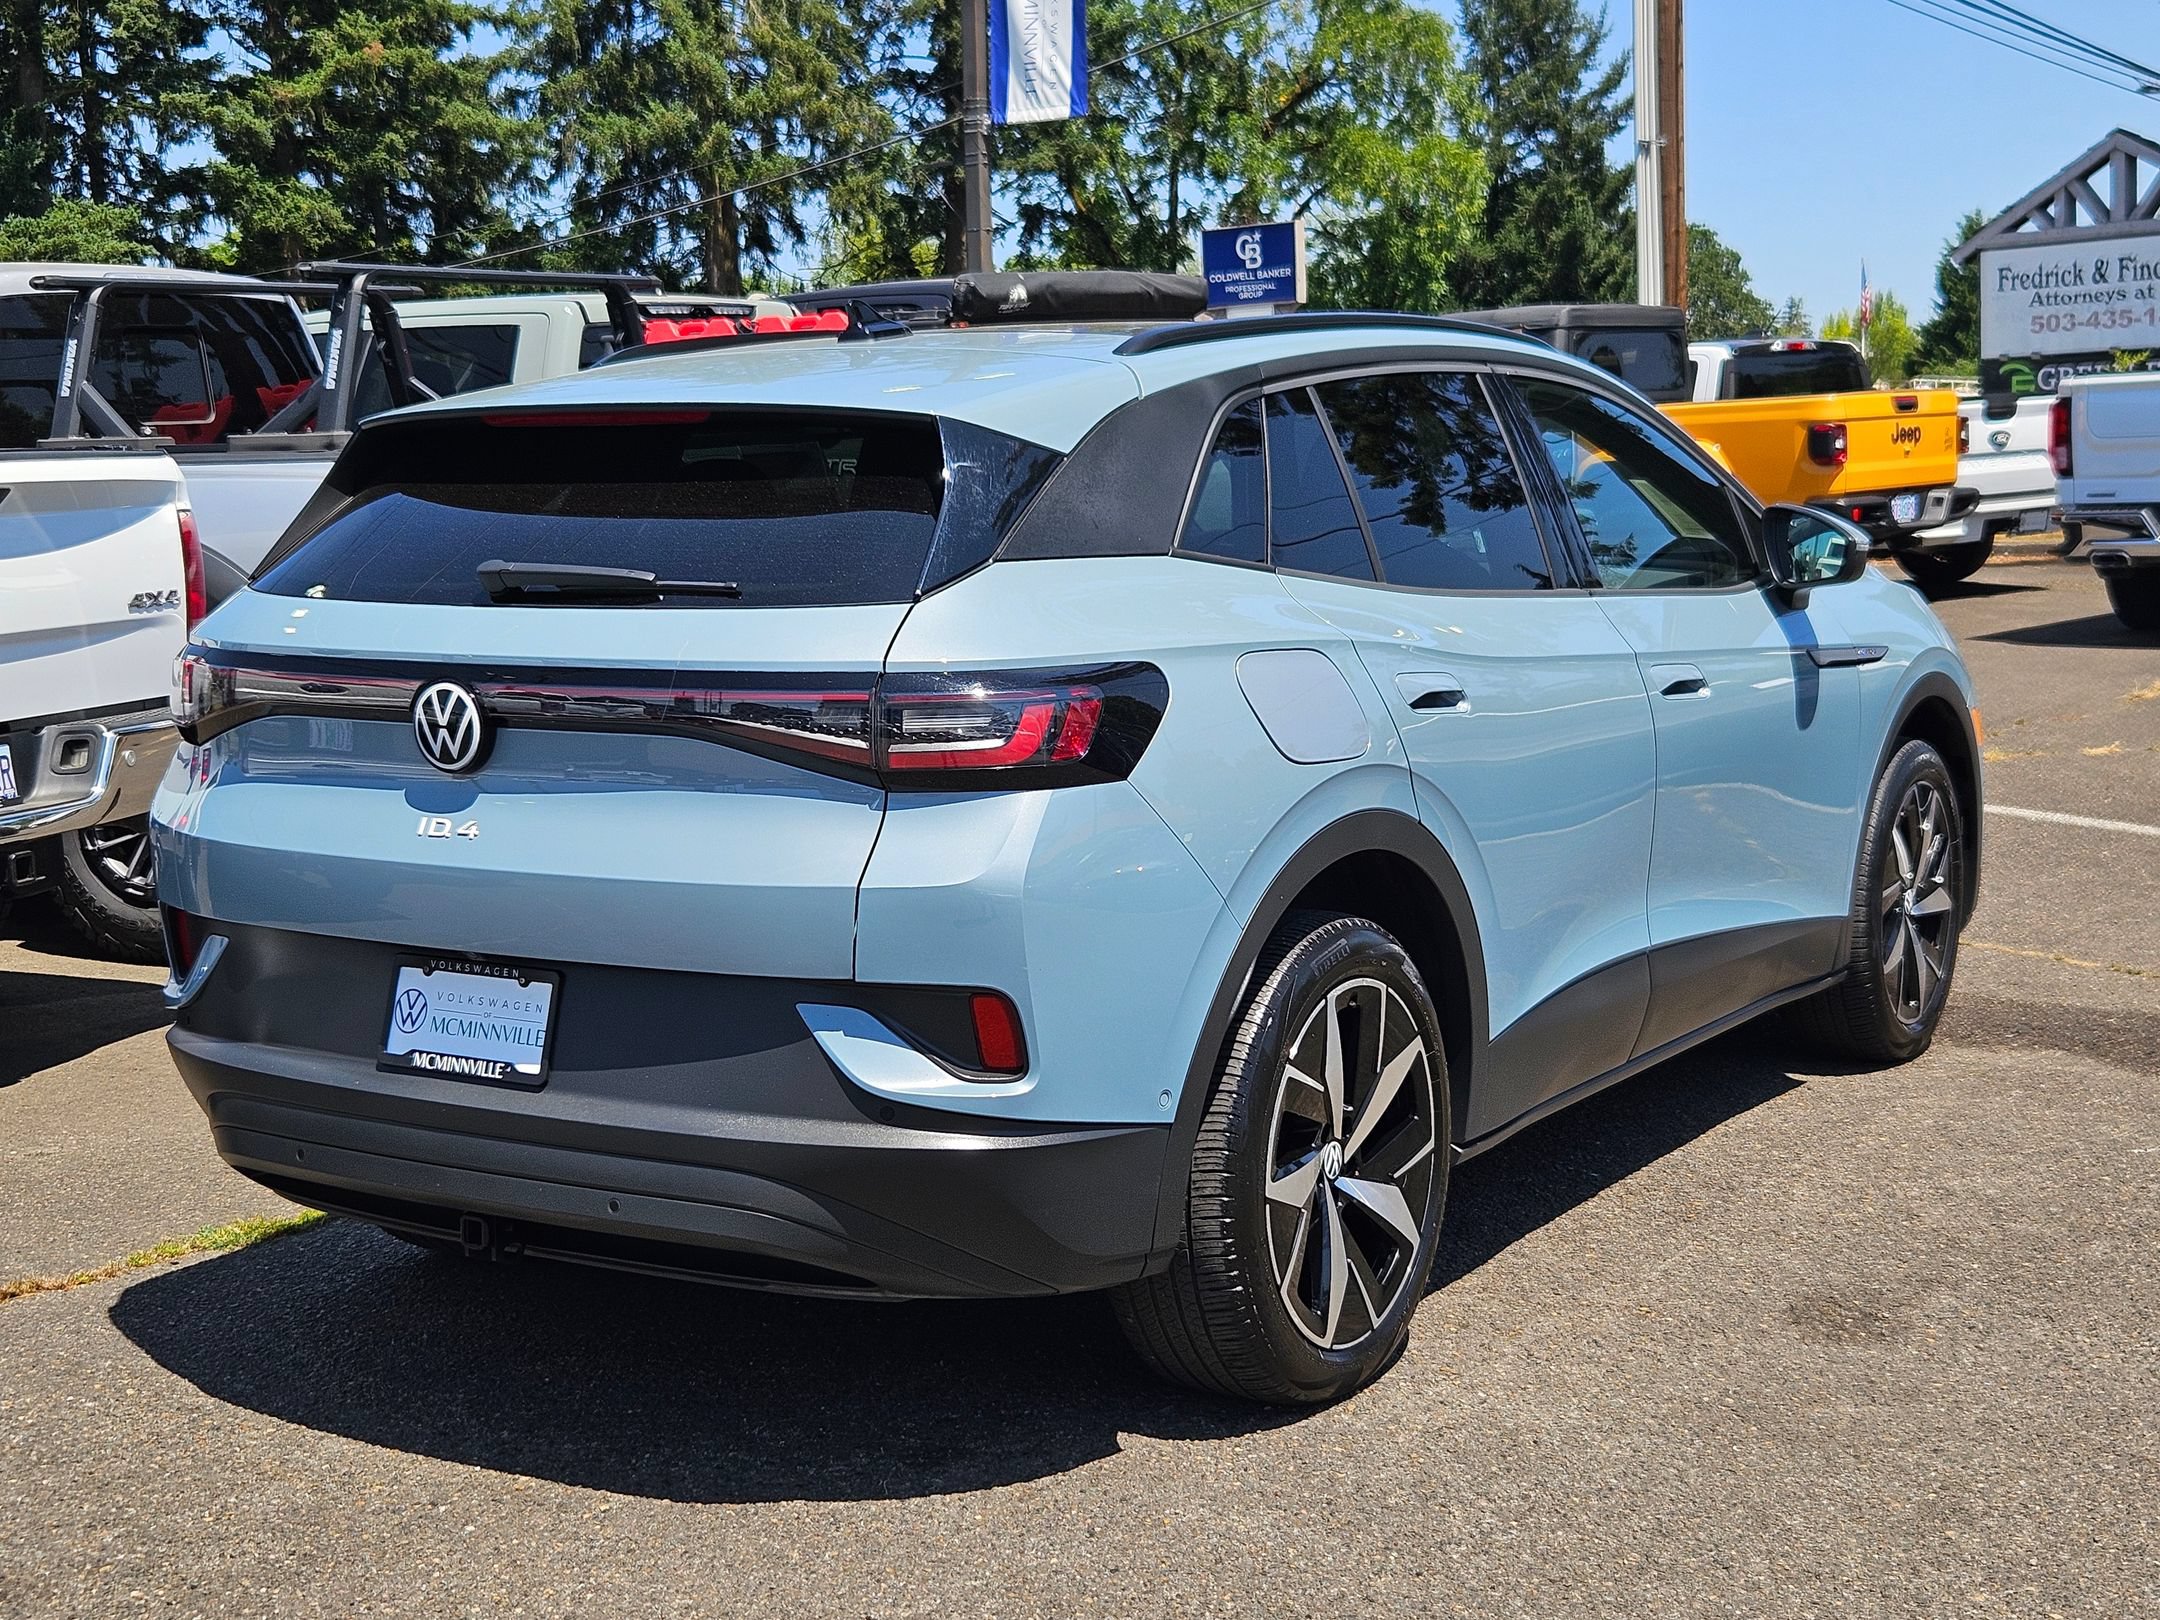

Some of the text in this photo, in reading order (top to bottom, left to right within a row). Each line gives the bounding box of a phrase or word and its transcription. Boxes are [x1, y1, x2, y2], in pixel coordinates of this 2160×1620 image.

[1209, 267, 1292, 284] COLDWELL BANKER
[1997, 260, 2085, 293] Fredrick
[2091, 257, 2110, 285] &
[1225, 283, 1277, 294] PROFESSIONAL
[1238, 290, 1264, 300] GROUP
[2028, 283, 2155, 308] Attorneys at
[2030, 307, 2160, 335] 503-435-1
[60, 338, 78, 397] YAKIMA
[325, 328, 343, 390] YAKIMA
[1891, 422, 1922, 447] Jeep
[430, 959, 520, 978] VOLKSWAGEN
[437, 991, 544, 1014] VOLKSWAGEN
[483, 1011, 493, 1019] OF
[429, 1015, 547, 1048] MCMINNVILLE
[412, 1051, 505, 1079] MCMINNVILLE
